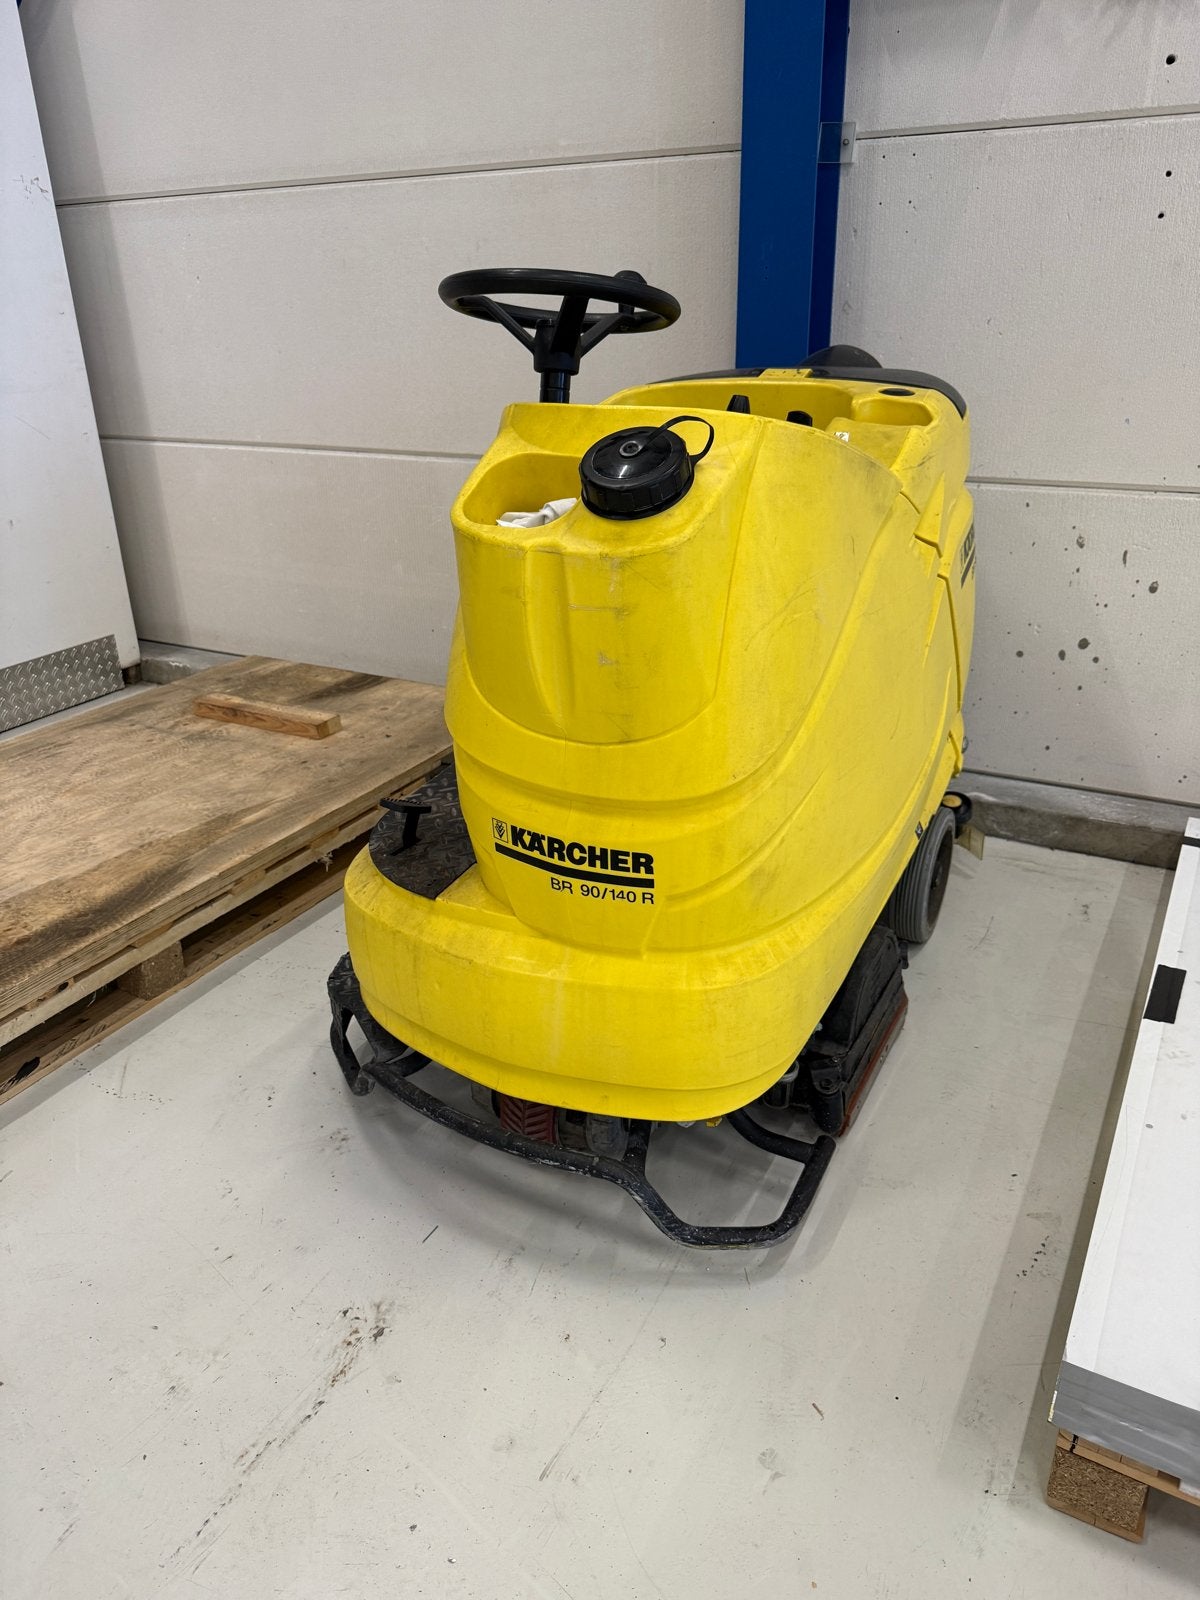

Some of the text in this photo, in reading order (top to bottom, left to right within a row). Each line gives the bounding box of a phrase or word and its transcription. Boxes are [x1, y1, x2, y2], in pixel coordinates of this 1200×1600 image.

[510, 824, 655, 875] KÄRCHER
[550, 876, 655, 905] BR 90/140 R
